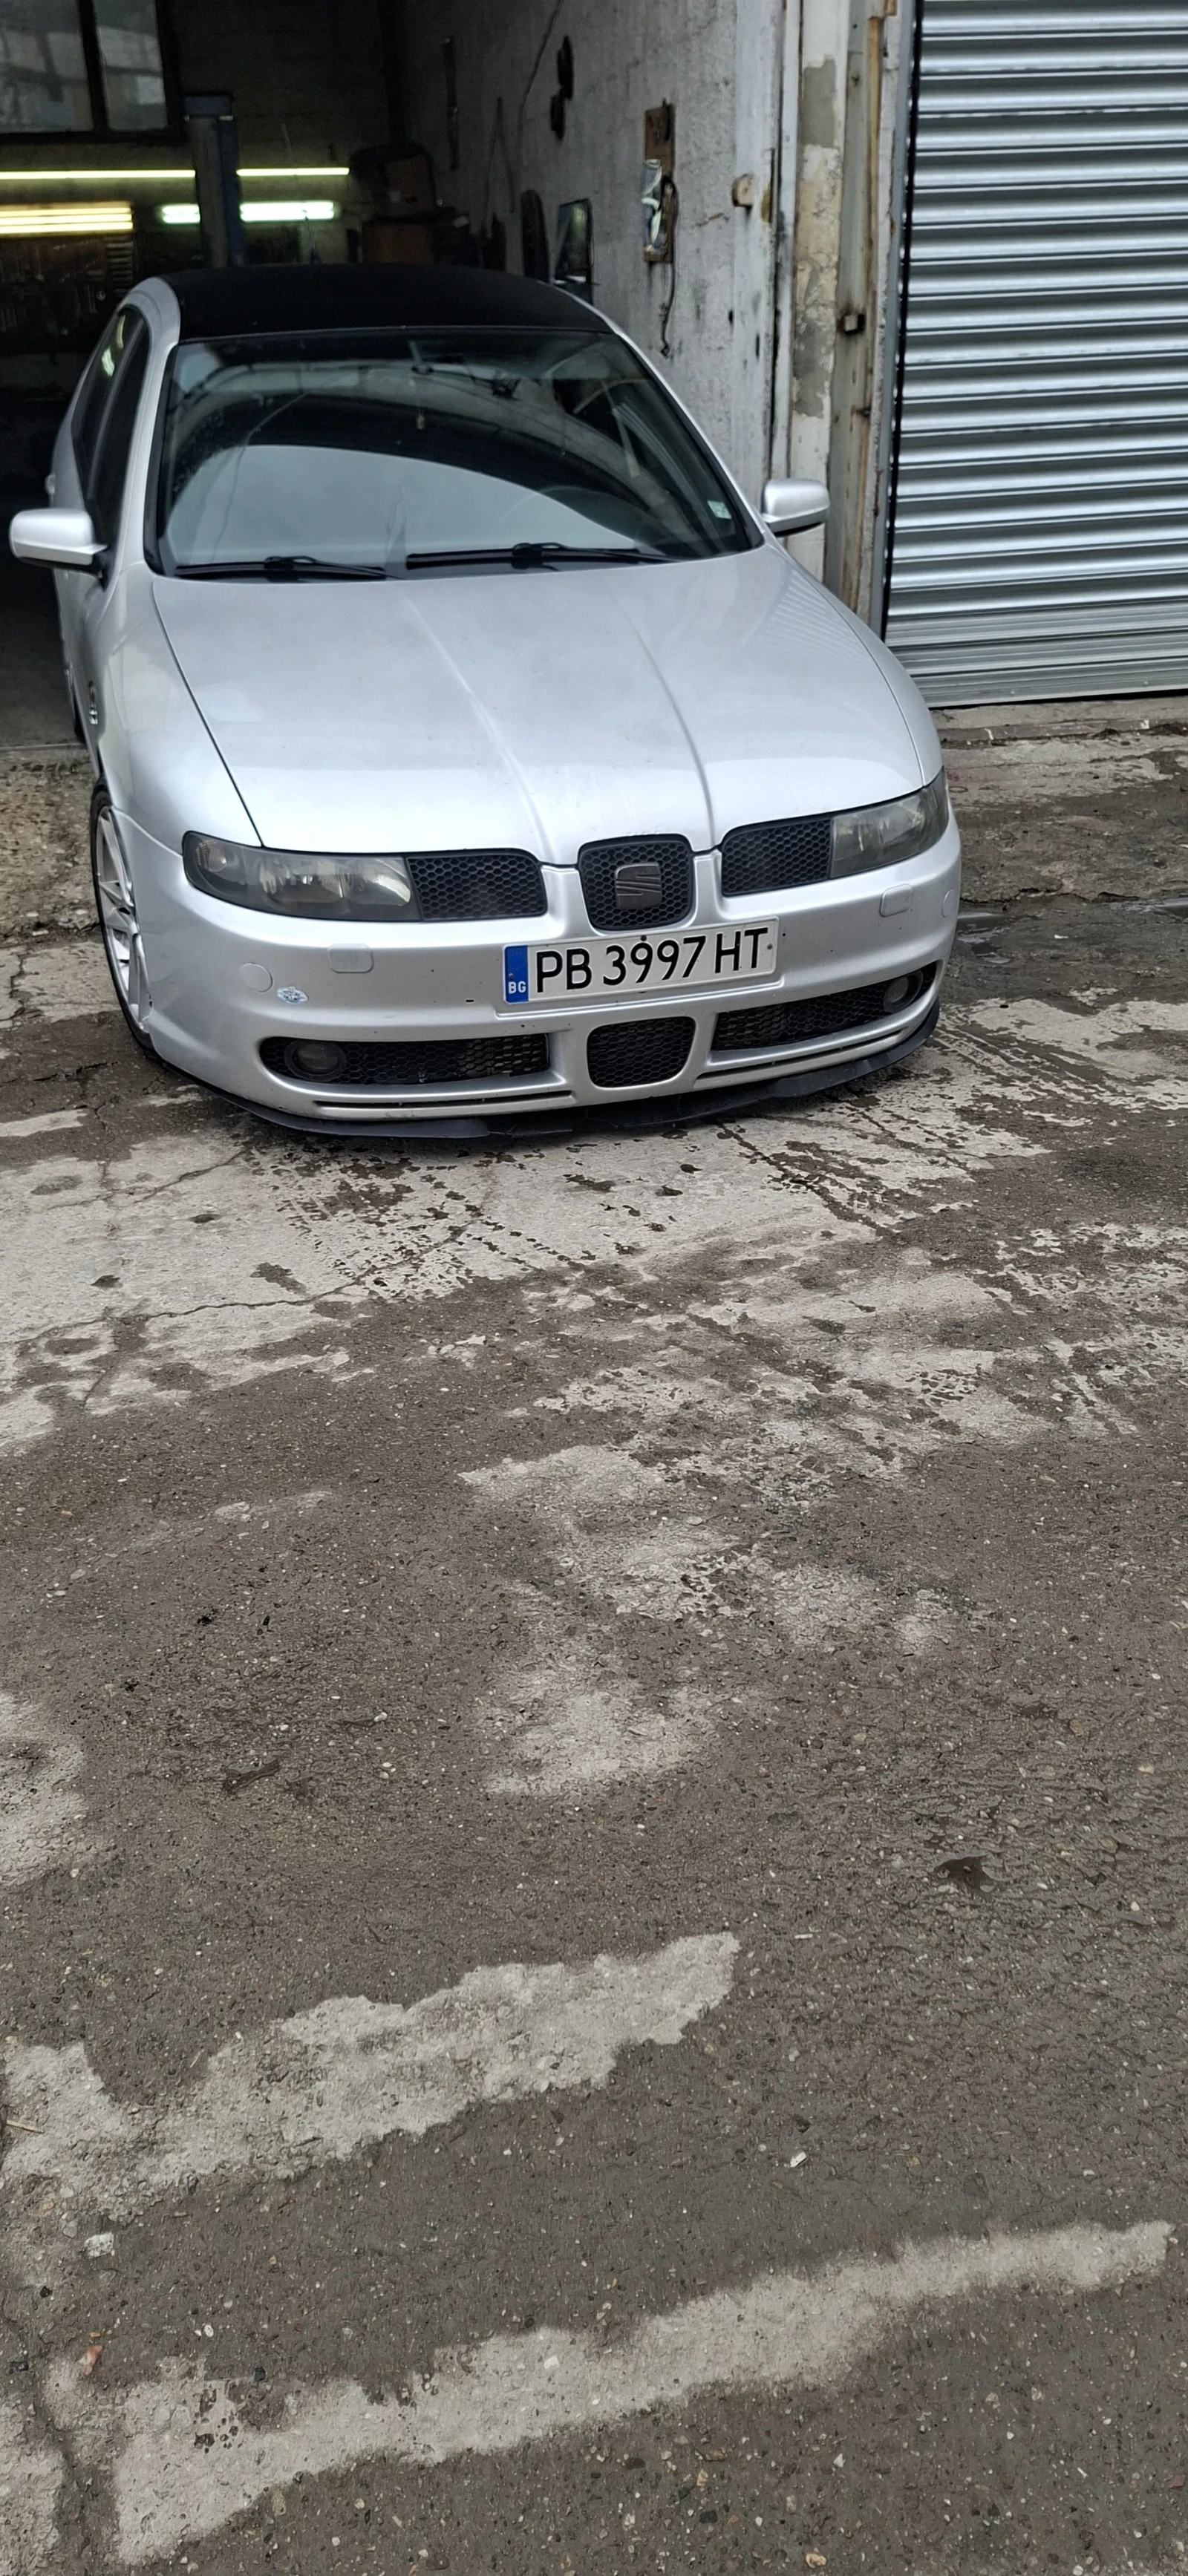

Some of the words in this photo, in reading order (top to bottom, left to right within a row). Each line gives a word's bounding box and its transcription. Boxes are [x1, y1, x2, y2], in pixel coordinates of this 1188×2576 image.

[536, 948, 592, 993] PB
[603, 936, 706, 986] 3997
[714, 927, 768, 973] HT
[508, 981, 526, 994] BG
